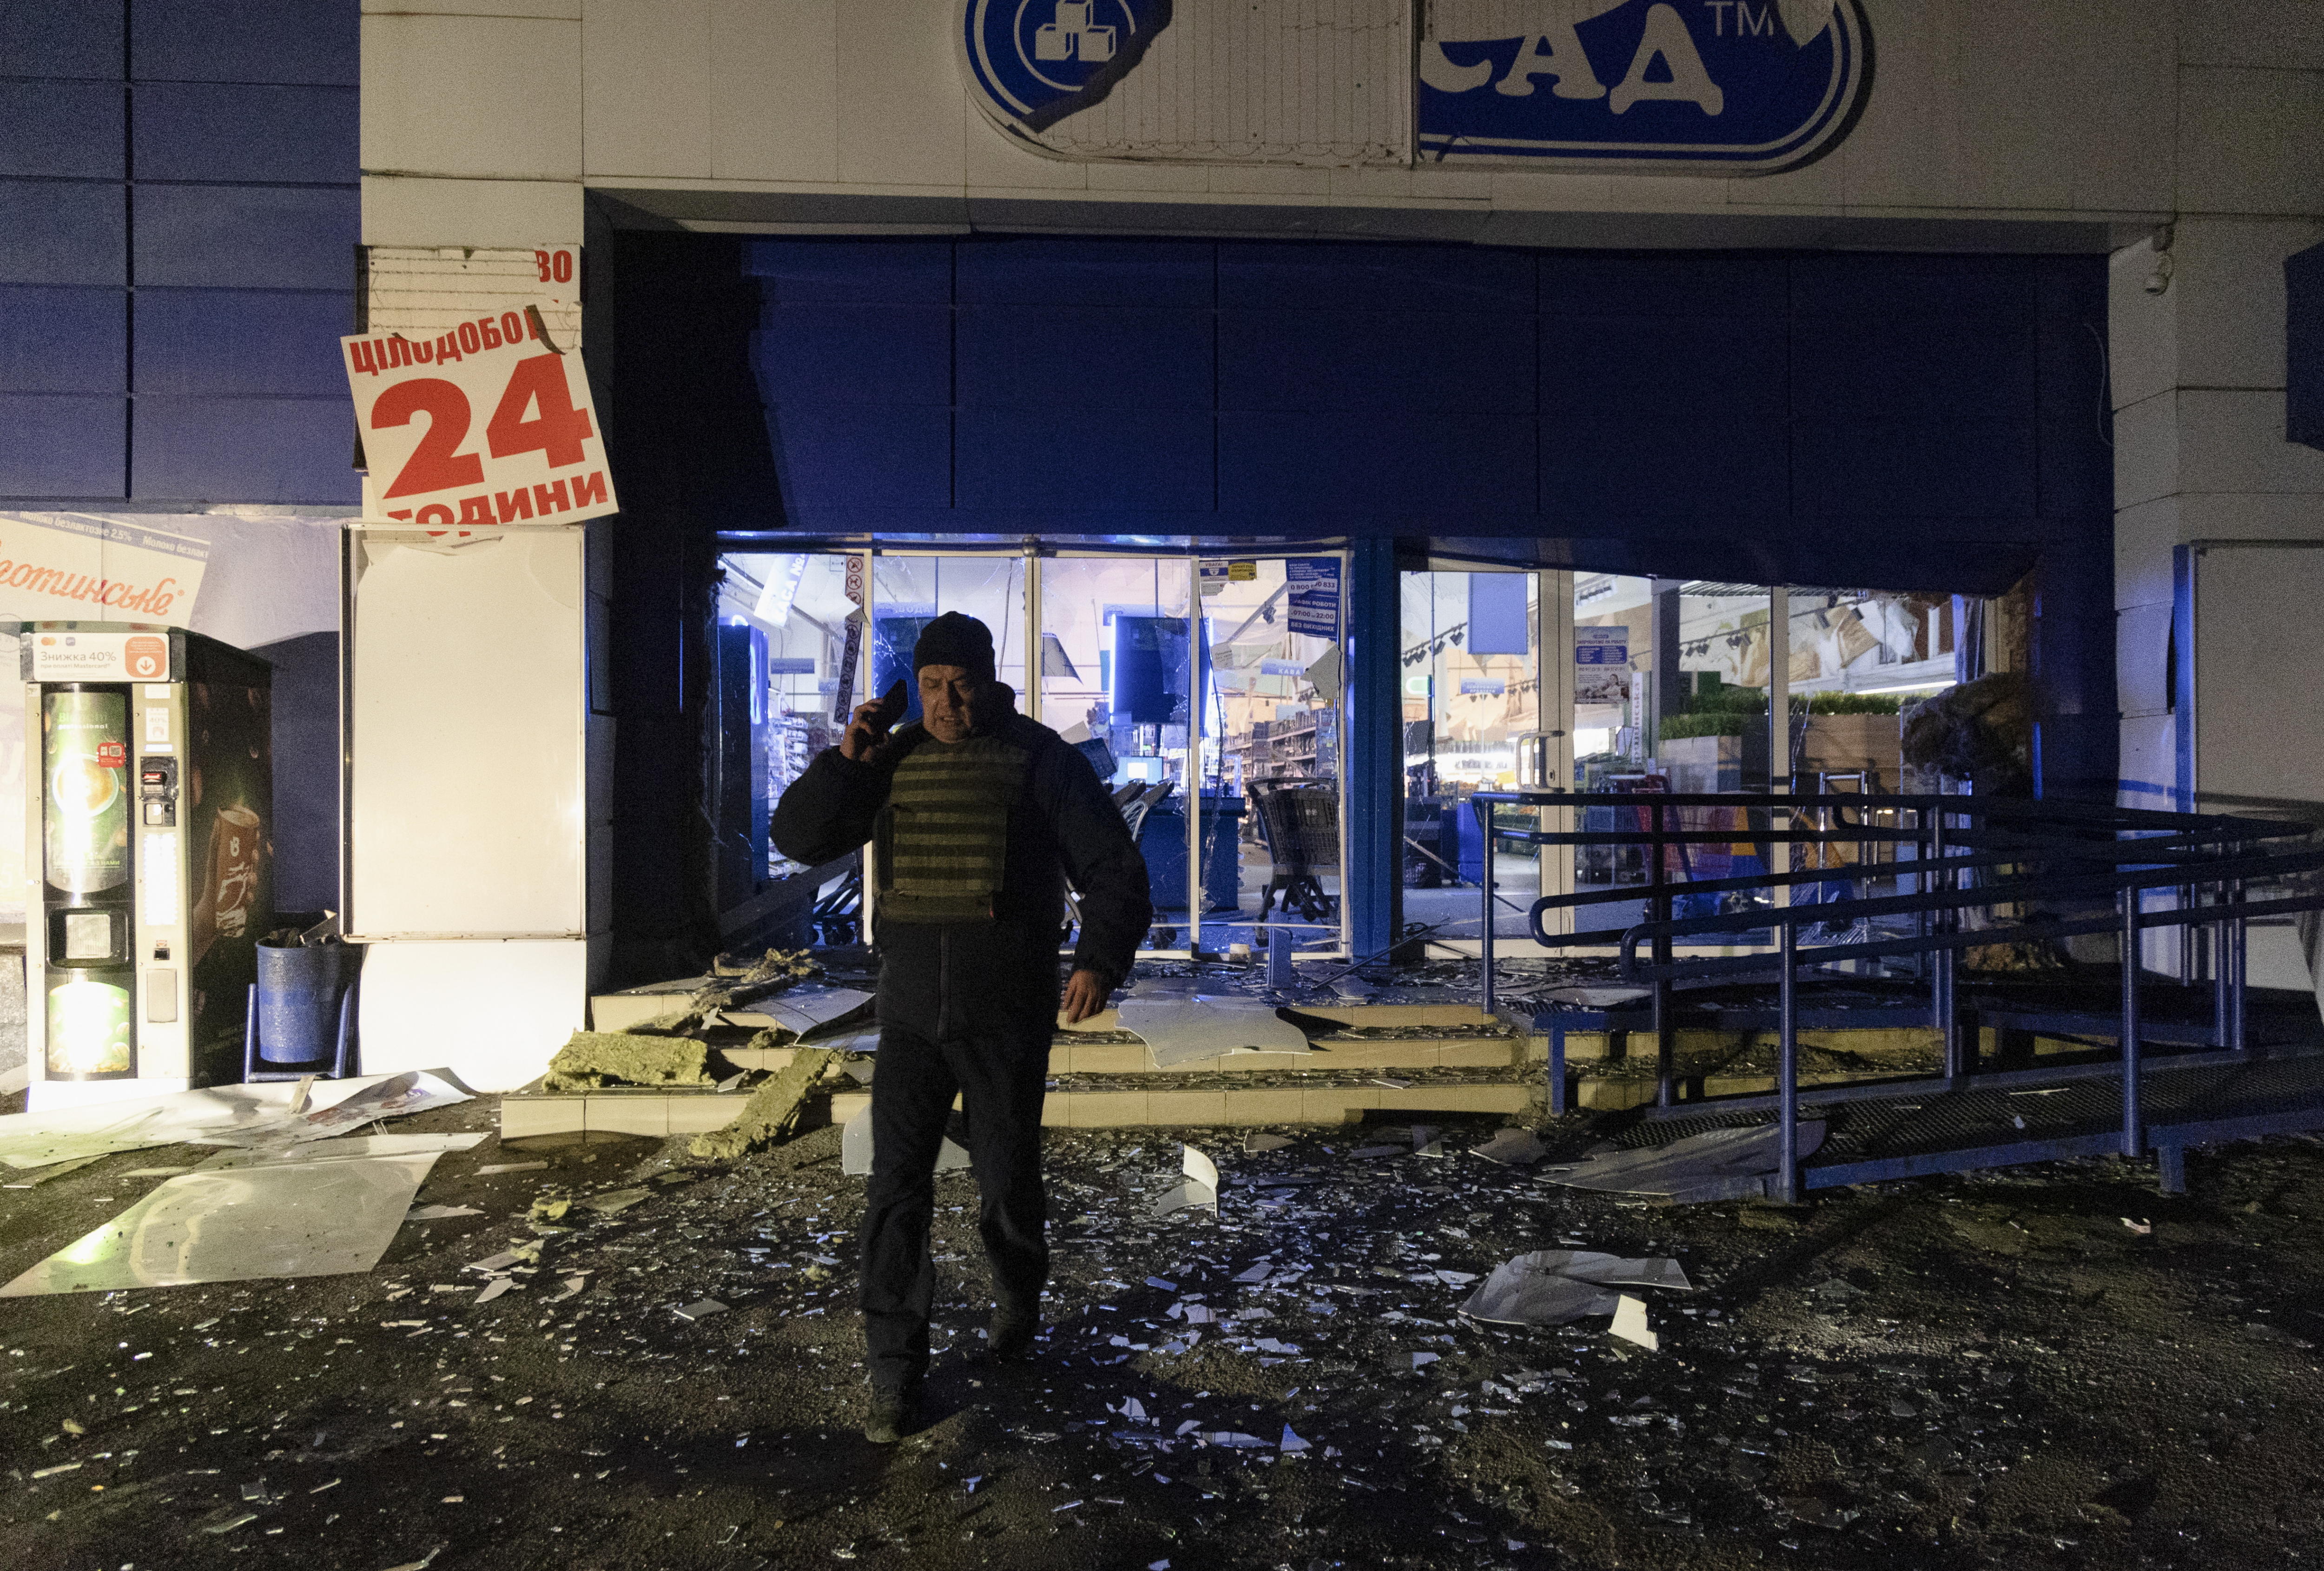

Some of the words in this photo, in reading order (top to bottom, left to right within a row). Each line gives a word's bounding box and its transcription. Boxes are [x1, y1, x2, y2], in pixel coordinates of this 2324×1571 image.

[371, 352, 594, 499] 24
[20, 511, 53, 525] Молоко
[143, 536, 176, 551] Молоко
[1303, 623, 1334, 631] ВИХІДНИХ
[40, 651, 86, 661] Знижка
[89, 651, 116, 661] 40%
